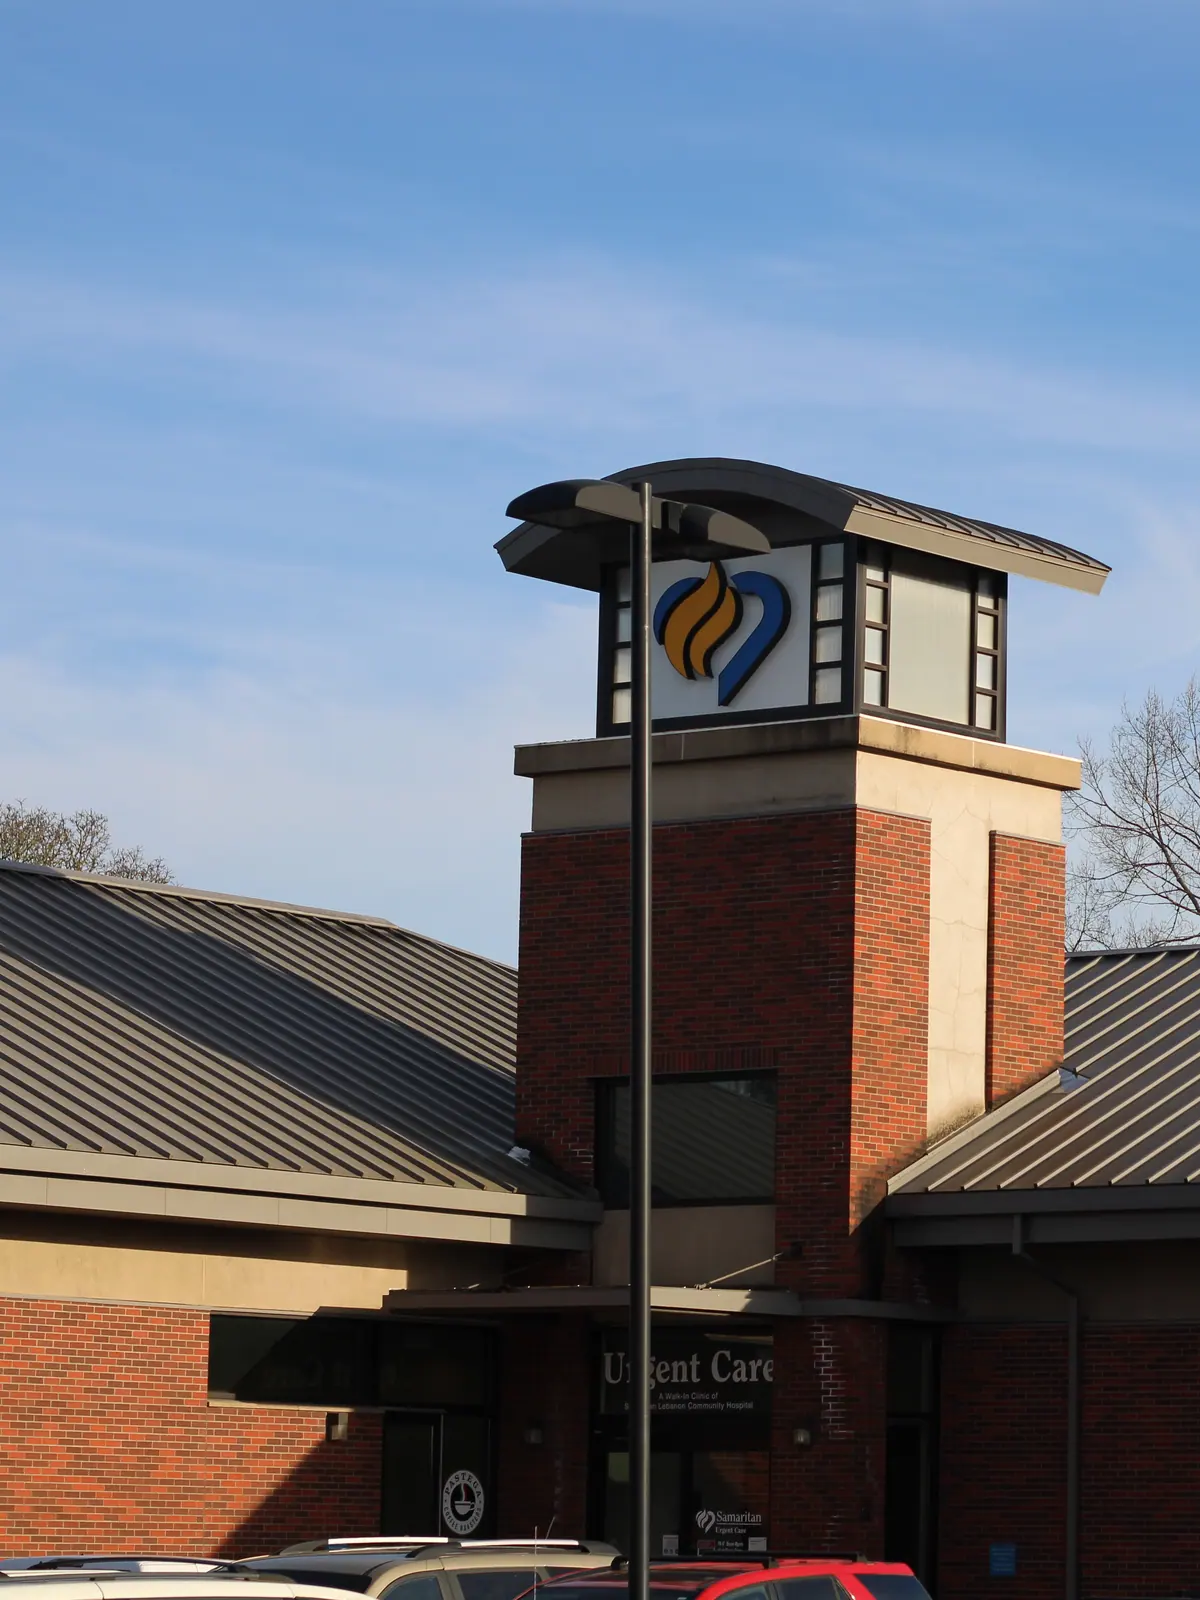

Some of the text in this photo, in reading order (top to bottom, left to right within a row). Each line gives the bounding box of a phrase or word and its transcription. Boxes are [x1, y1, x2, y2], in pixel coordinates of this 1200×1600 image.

[711, 1350, 774, 1383] Care
[658, 1391, 719, 1400] A Walk-In Clinic of
[658, 1402, 686, 1410] Lebanon
[688, 1402, 724, 1411] Community
[726, 1402, 754, 1411] Hospital
[444, 1472, 482, 1498] PASTEGA
[716, 1510, 762, 1523] Samaritan
[734, 1526, 747, 1534] Care
